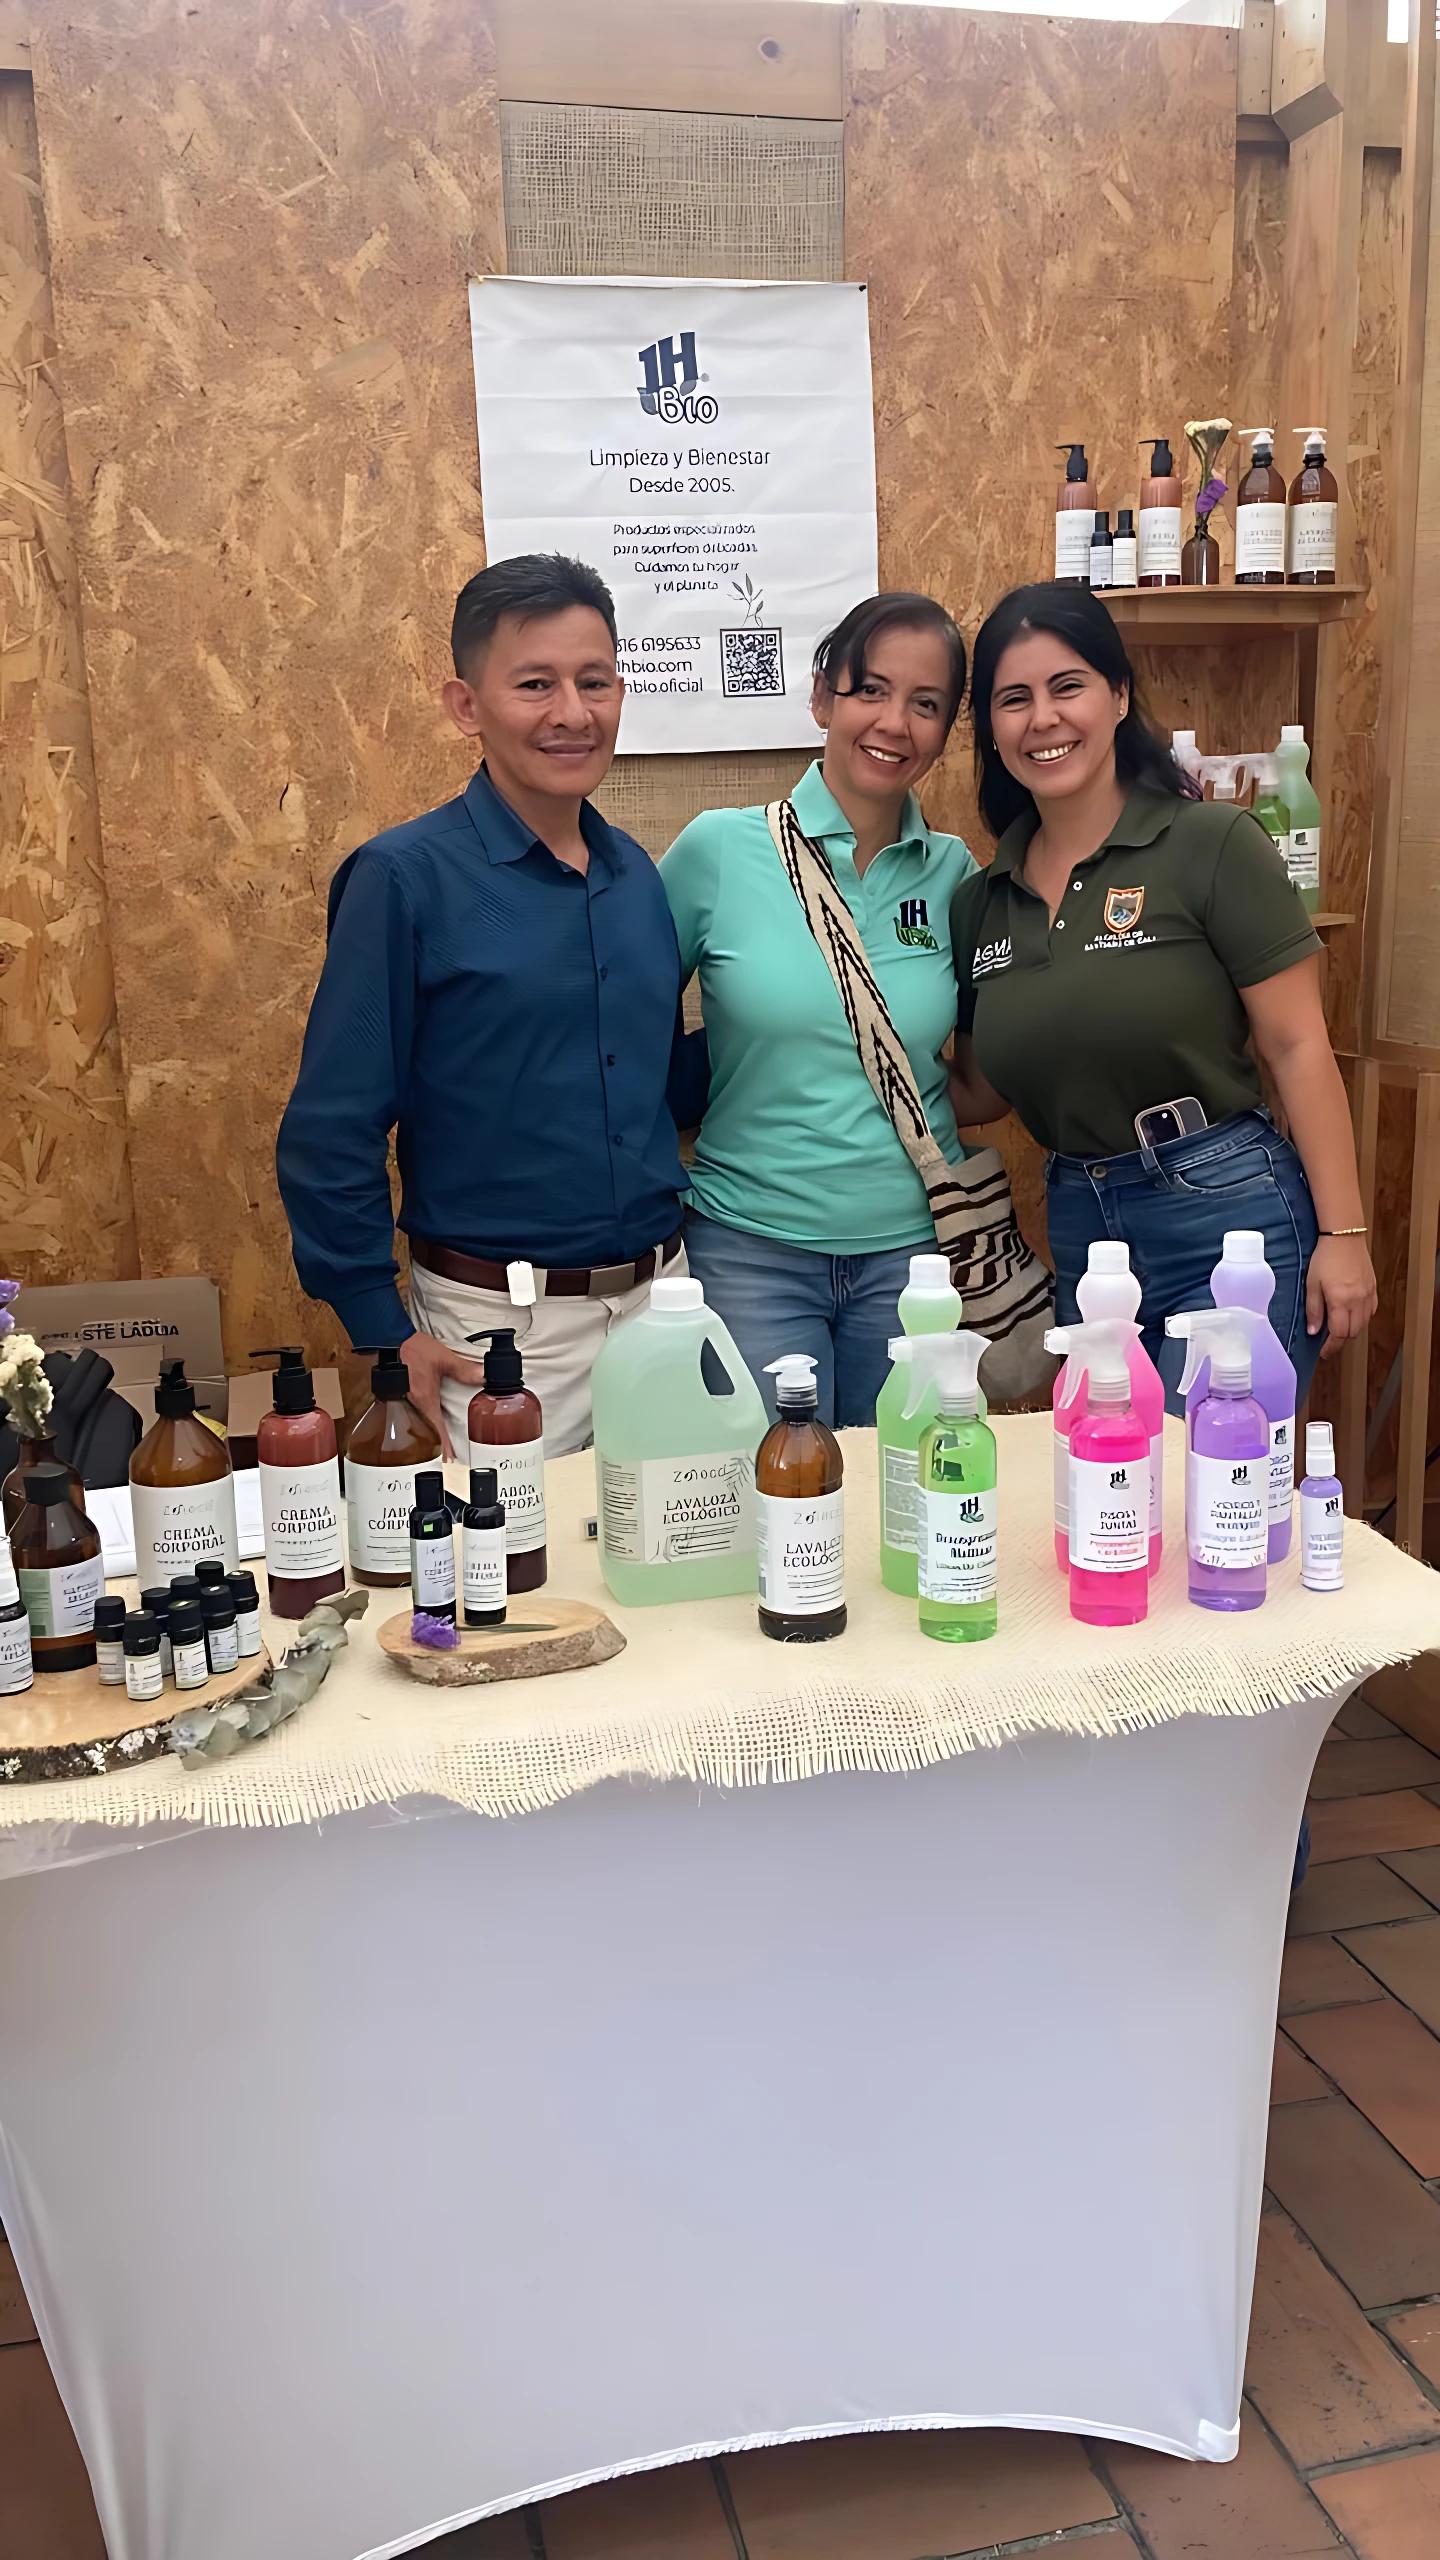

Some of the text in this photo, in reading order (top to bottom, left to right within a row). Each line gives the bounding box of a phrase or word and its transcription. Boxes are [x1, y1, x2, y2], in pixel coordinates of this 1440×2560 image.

[638, 331, 698, 396] 1H
[658, 386, 718, 424] Bio
[590, 447, 771, 469] Limpieza y Bienestar
[629, 477, 735, 493] Desde 2005.
[666, 1492, 737, 1511] LAVALOZA
[280, 1505, 331, 1521] CREMA
[163, 1524, 216, 1541] CREMA
[153, 1534, 226, 1553] CORPORAL
